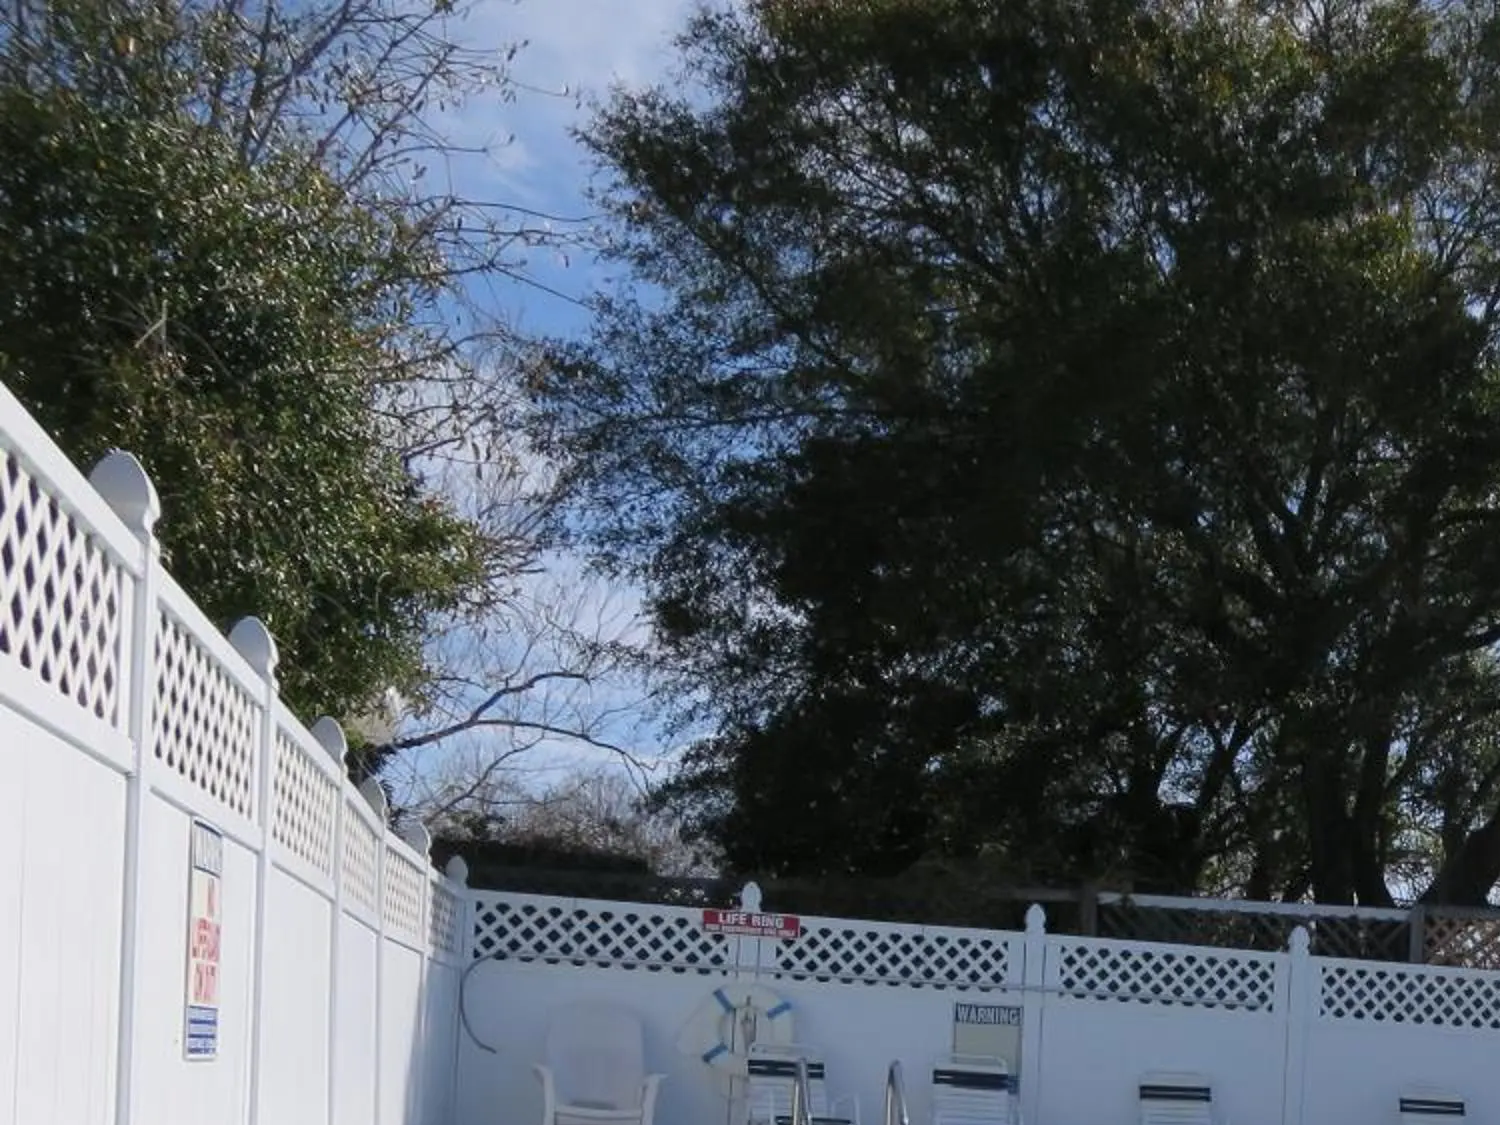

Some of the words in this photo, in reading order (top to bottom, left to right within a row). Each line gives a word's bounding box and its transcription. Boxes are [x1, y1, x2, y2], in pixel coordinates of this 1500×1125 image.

[718, 911, 748, 925] LIFE
[751, 915, 784, 930] RING
[957, 1005, 1019, 1025] WARNING
